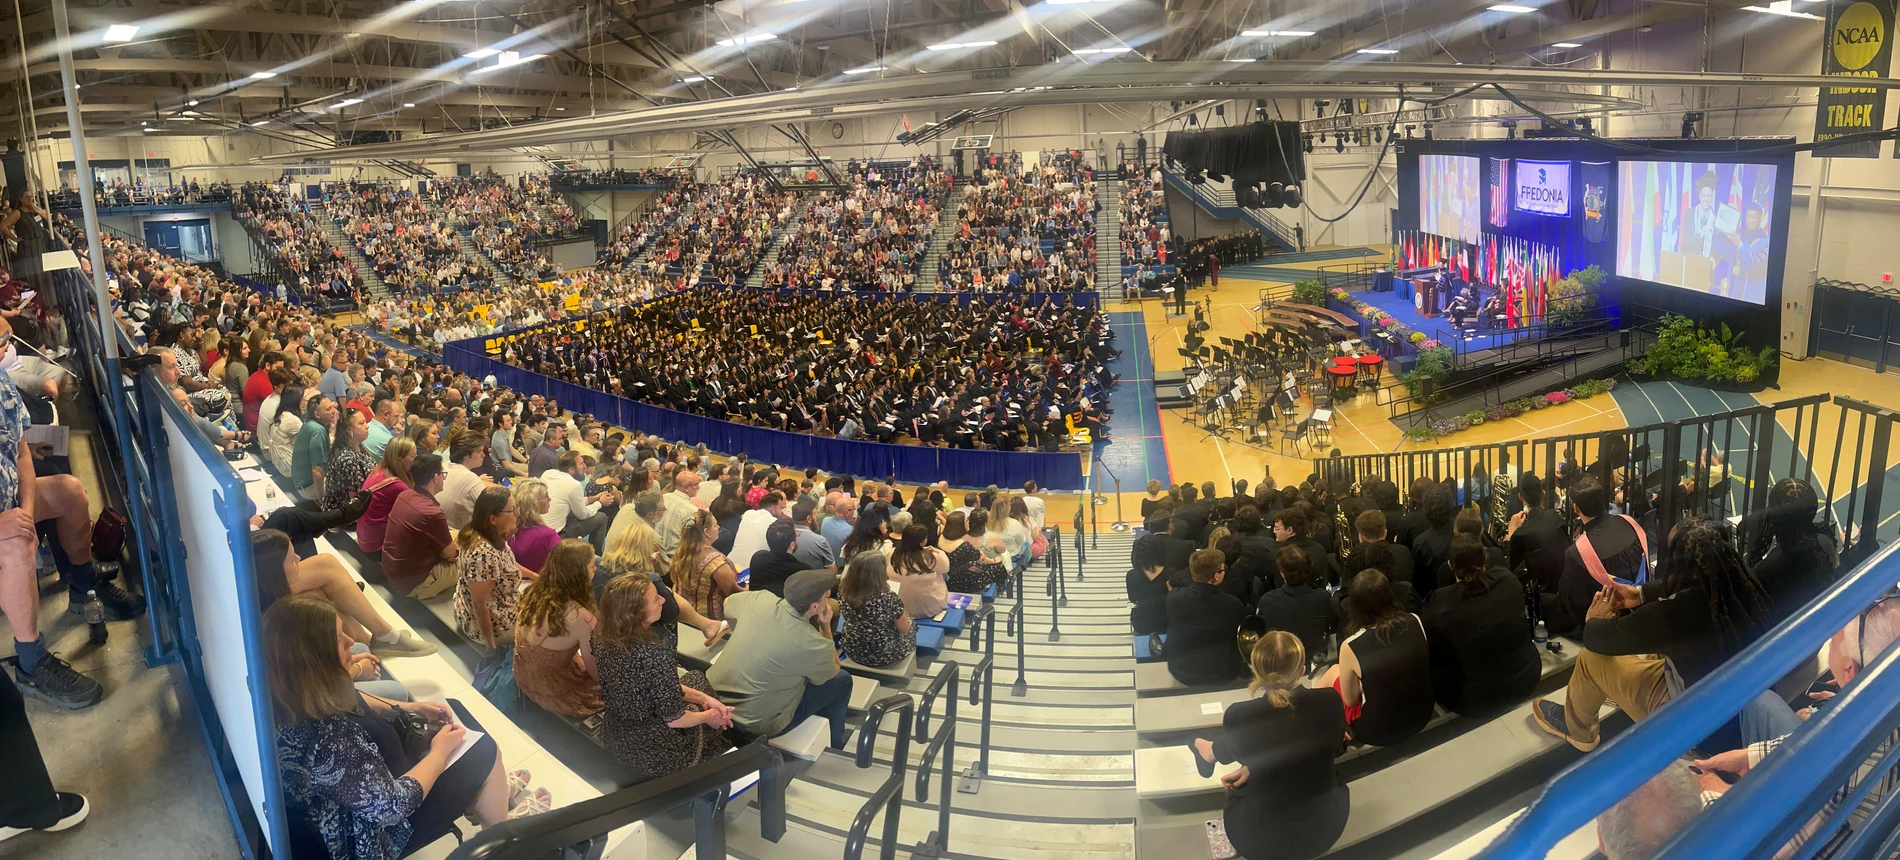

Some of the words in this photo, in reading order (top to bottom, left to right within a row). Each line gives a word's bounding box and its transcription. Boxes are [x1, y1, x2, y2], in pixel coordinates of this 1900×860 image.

[1836, 26, 1880, 45] NCAA
[1827, 104, 1873, 127] TRACK
[1521, 185, 1563, 203] FREDONIA
